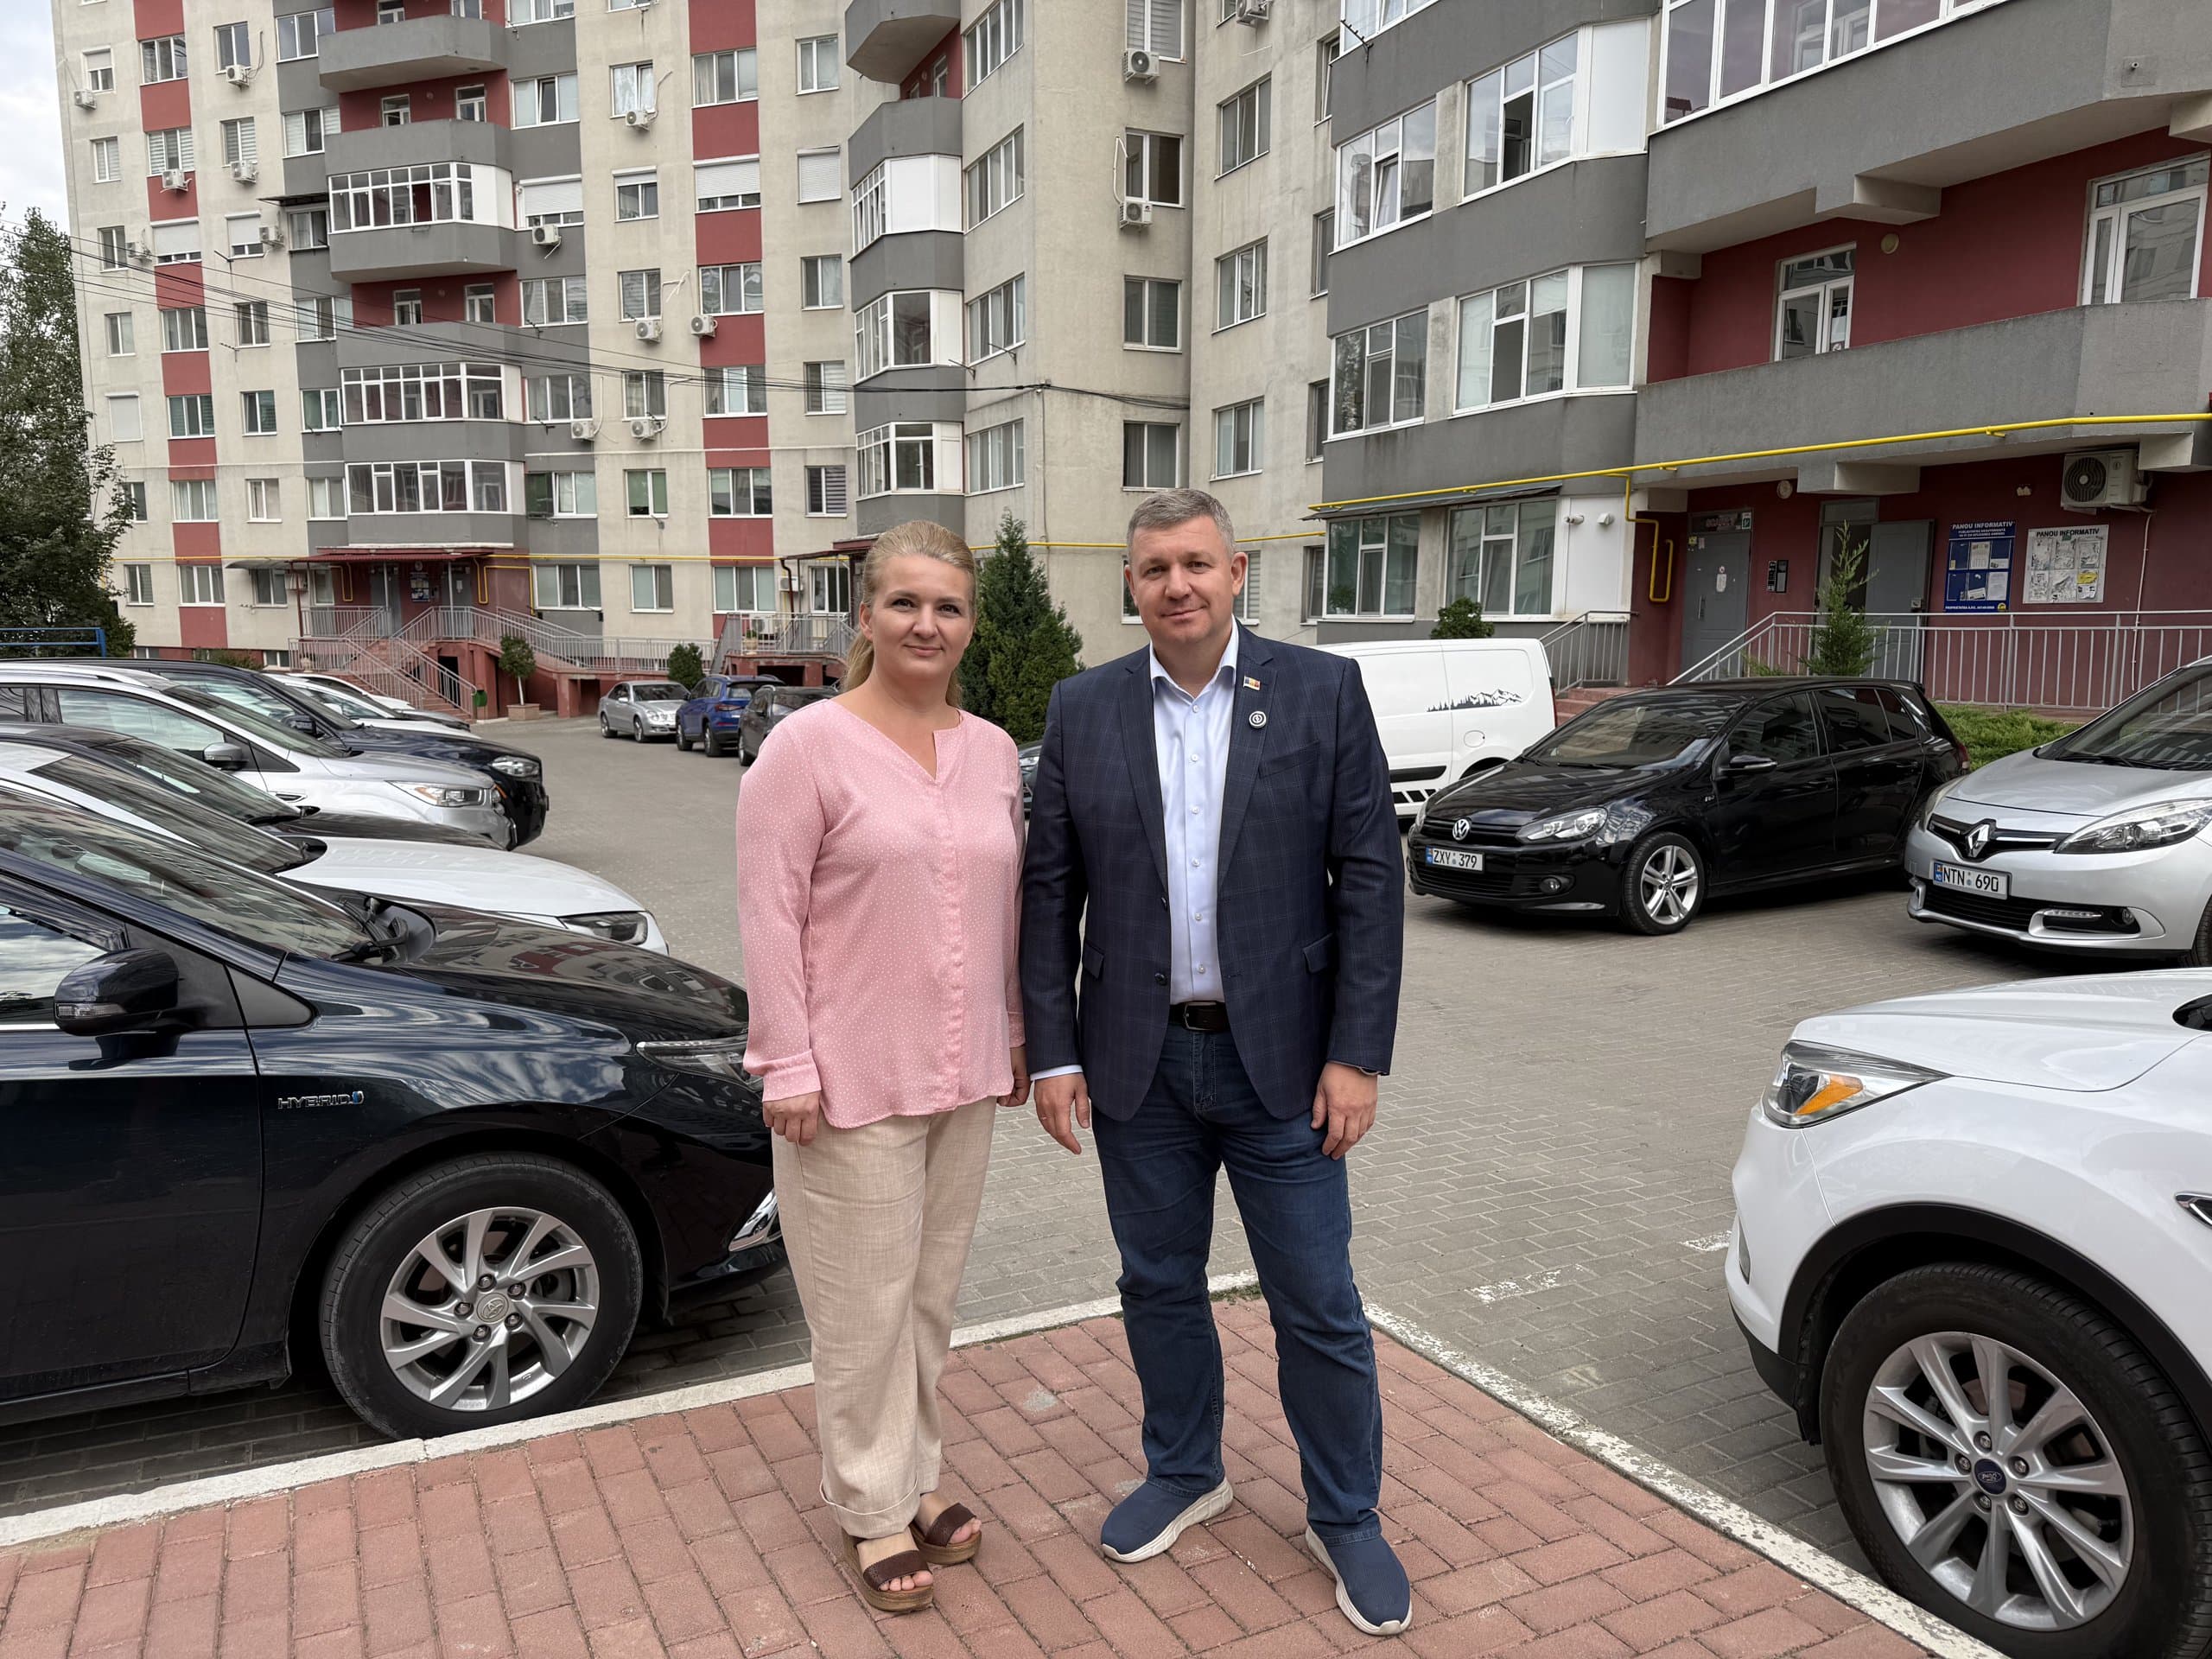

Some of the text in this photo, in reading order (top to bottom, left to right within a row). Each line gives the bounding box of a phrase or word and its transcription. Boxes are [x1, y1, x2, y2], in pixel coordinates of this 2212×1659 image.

[2059, 528, 2100, 537] INFORMATIV
[1433, 849, 1478, 868] ZXY 379
[1943, 867, 1999, 892] NTN 690
[277, 1093, 351, 1109] HYBRID
